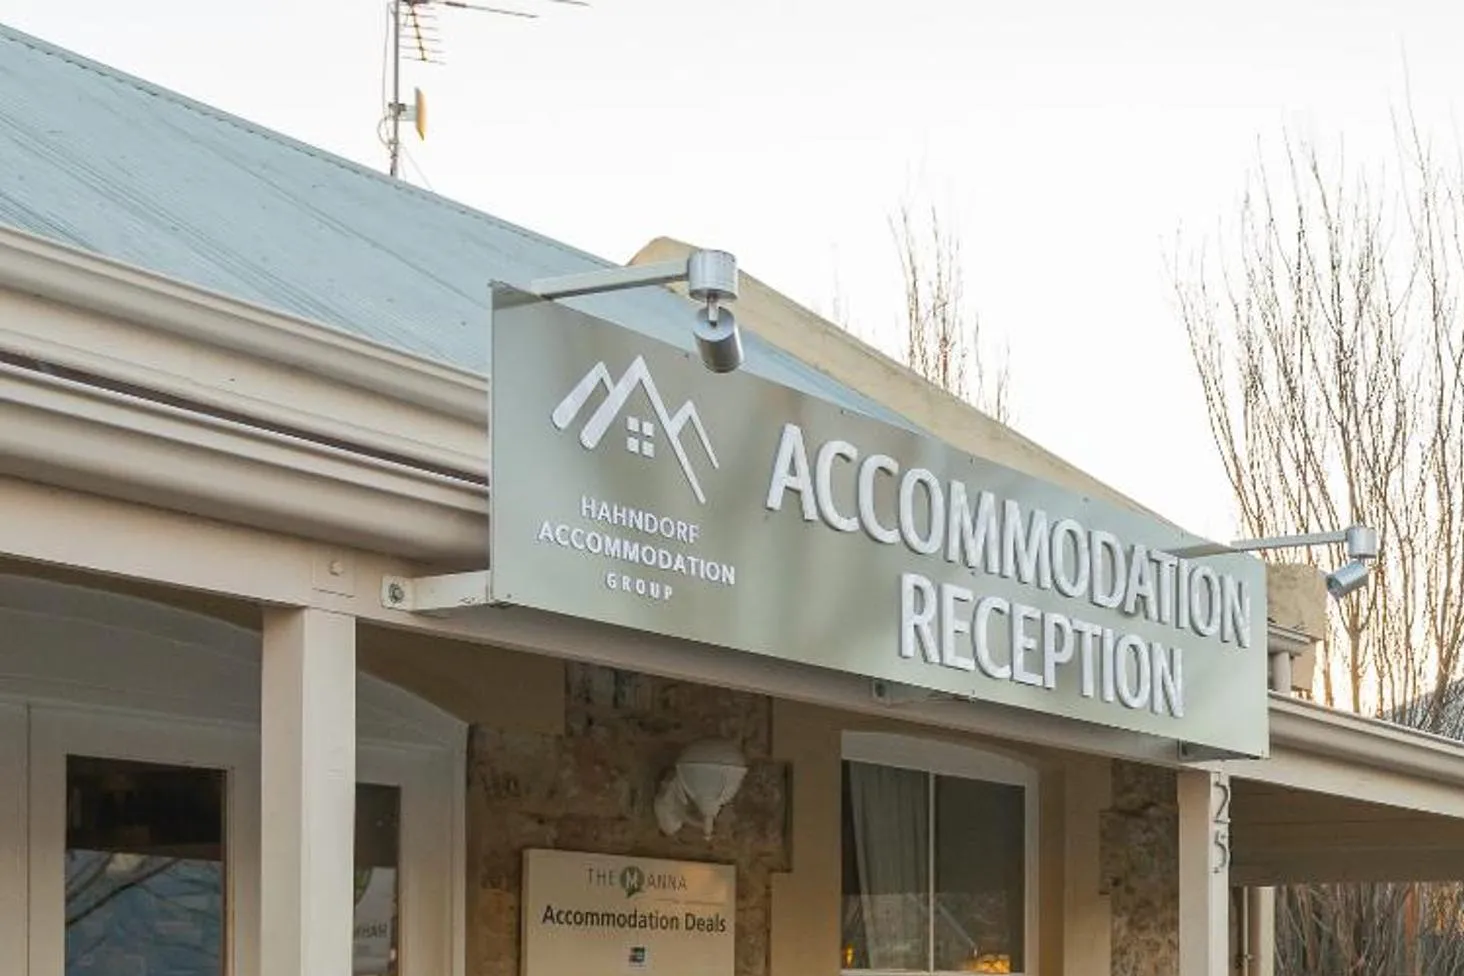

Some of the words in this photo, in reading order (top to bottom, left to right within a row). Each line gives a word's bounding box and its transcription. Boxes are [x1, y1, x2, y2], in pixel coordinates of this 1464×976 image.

[581, 495, 701, 543] HAHNDORF
[766, 423, 1250, 648] ACCOMMODATION
[538, 521, 736, 585] ACCOMMODATION
[605, 572, 674, 600] GROUP
[901, 574, 1185, 717] RECEPTION
[586, 868, 615, 887] THE
[626, 868, 688, 891] MANNA
[542, 905, 680, 930] Accommodation
[685, 912, 726, 933] Deals
